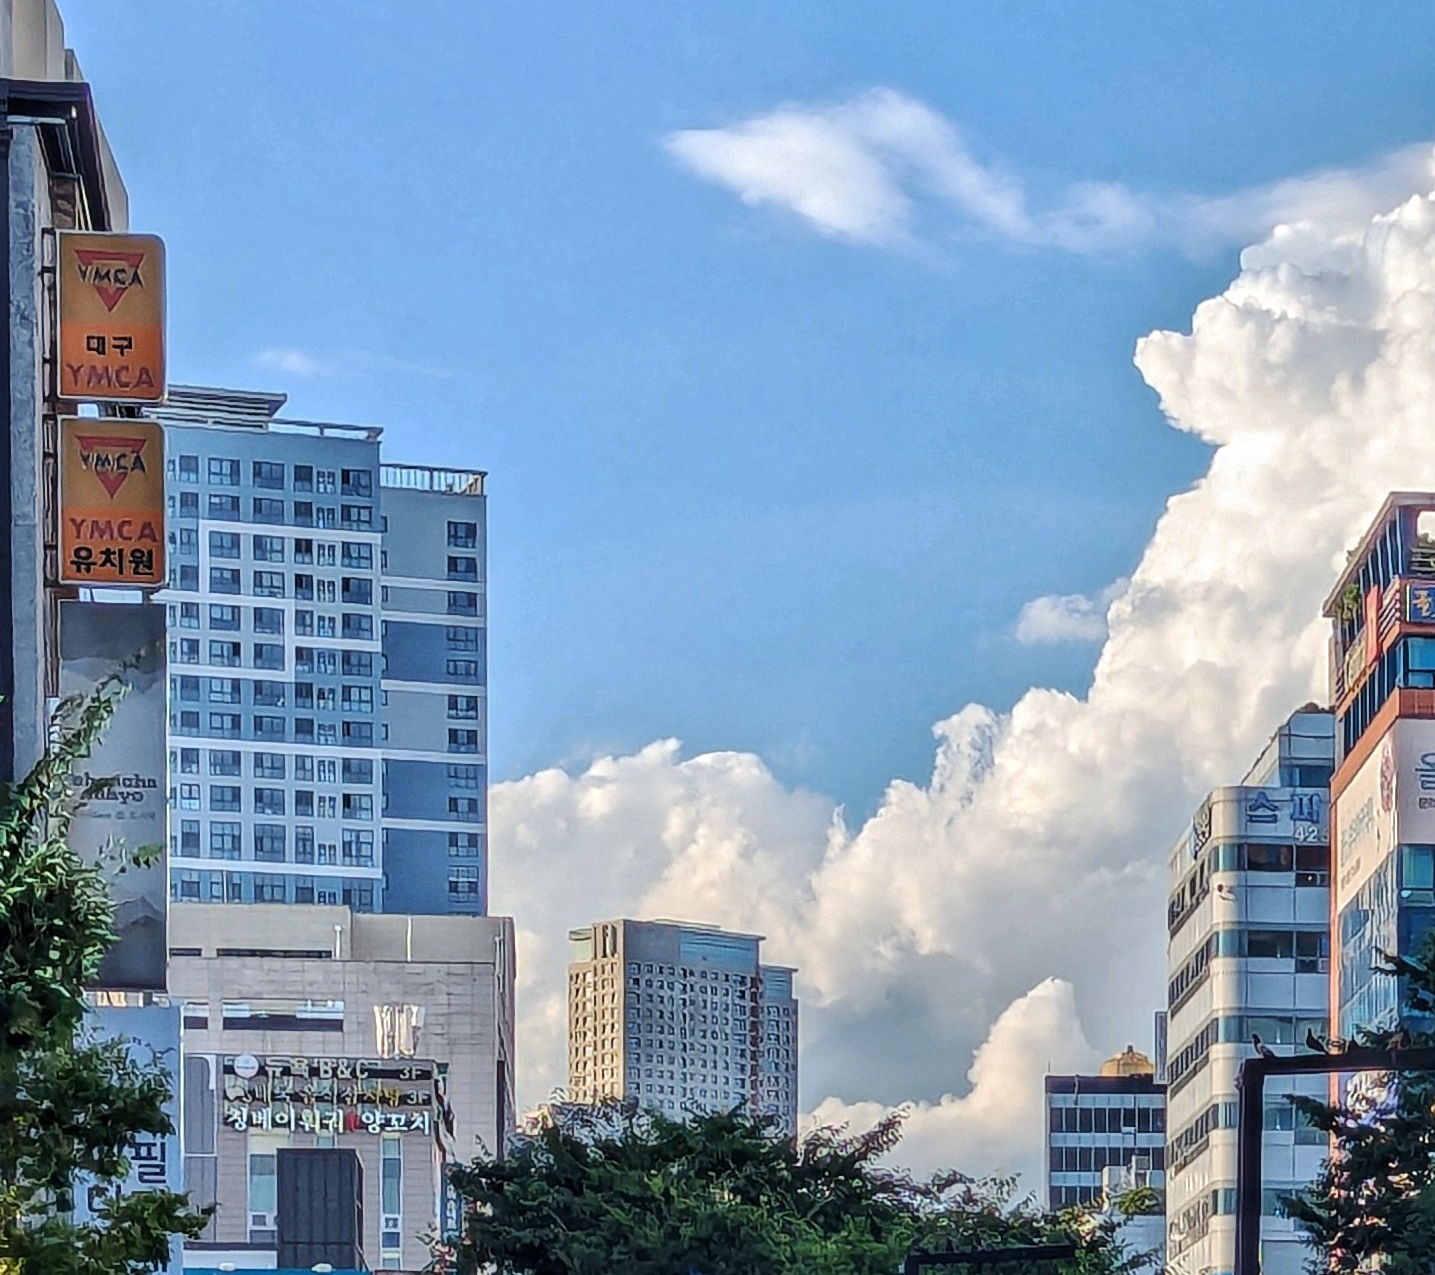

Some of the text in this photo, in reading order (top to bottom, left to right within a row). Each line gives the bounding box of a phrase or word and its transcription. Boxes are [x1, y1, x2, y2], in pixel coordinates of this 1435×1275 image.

[78, 264, 144, 287] YMCA
[86, 335, 133, 357] 대구
[66, 364, 155, 390] YMCA
[80, 450, 146, 474] YMCA
[70, 517, 158, 543] YMCA
[69, 545, 156, 576] 유치원
[400, 1066, 422, 1079] 3F
[407, 1090, 431, 1105] 3F
